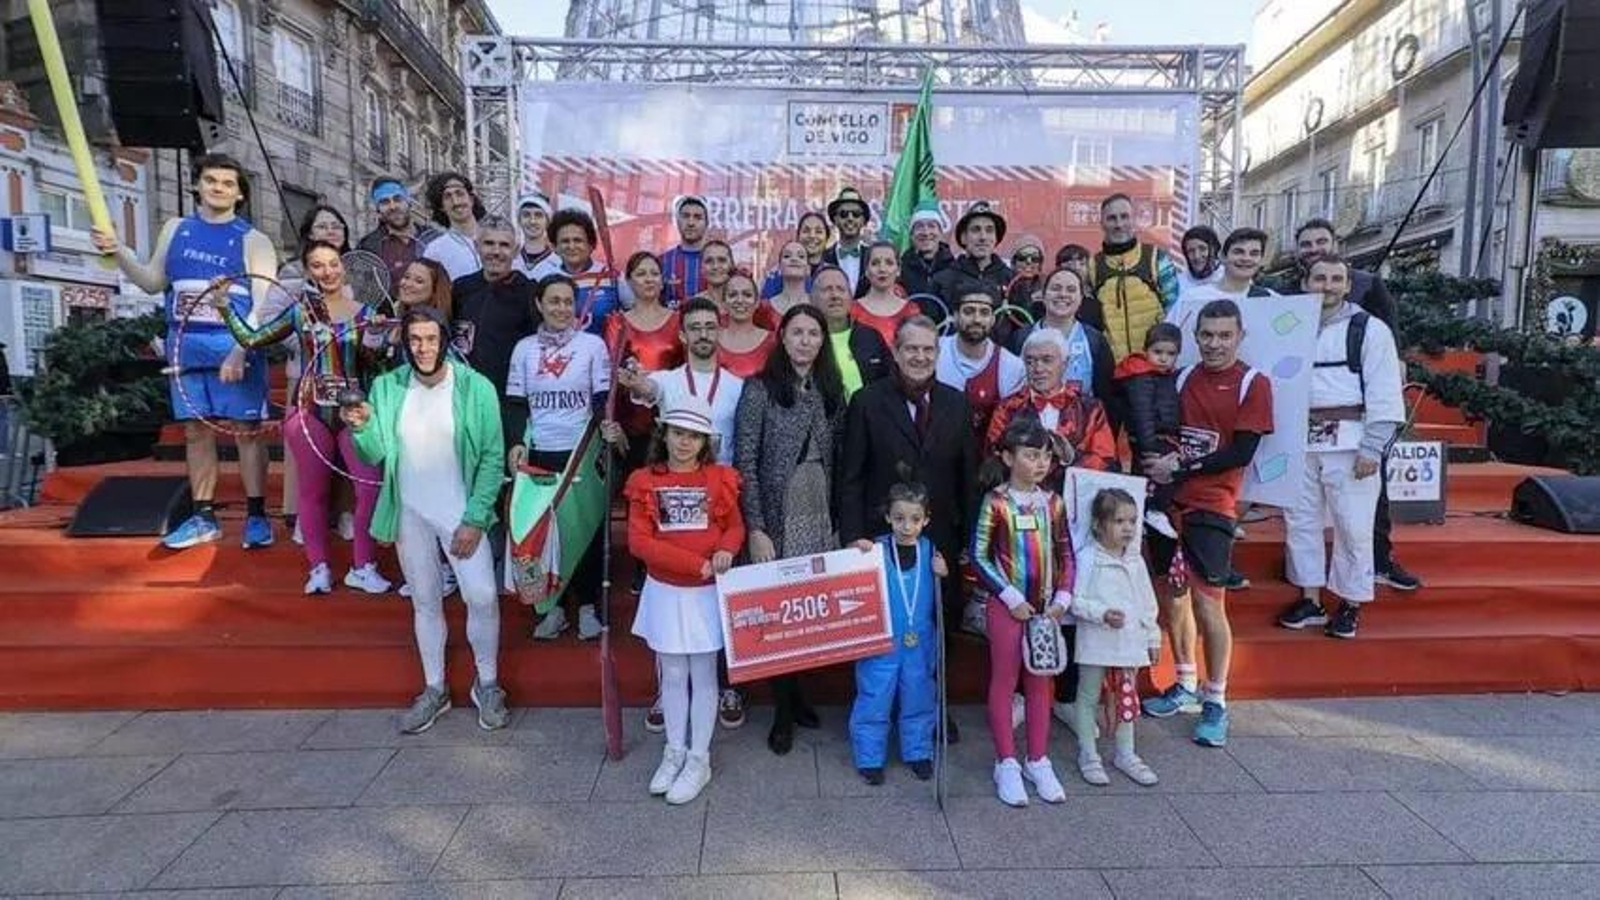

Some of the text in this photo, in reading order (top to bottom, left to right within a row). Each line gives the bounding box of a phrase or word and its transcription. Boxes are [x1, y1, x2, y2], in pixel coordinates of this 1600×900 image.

[795, 113, 879, 128] CONCELLO
[805, 131, 870, 144] DE VIGO
[182, 249, 228, 268] FRANCE
[1390, 446, 1438, 460] ALIDA
[667, 507, 702, 523] 302
[780, 593, 829, 625] 250€
